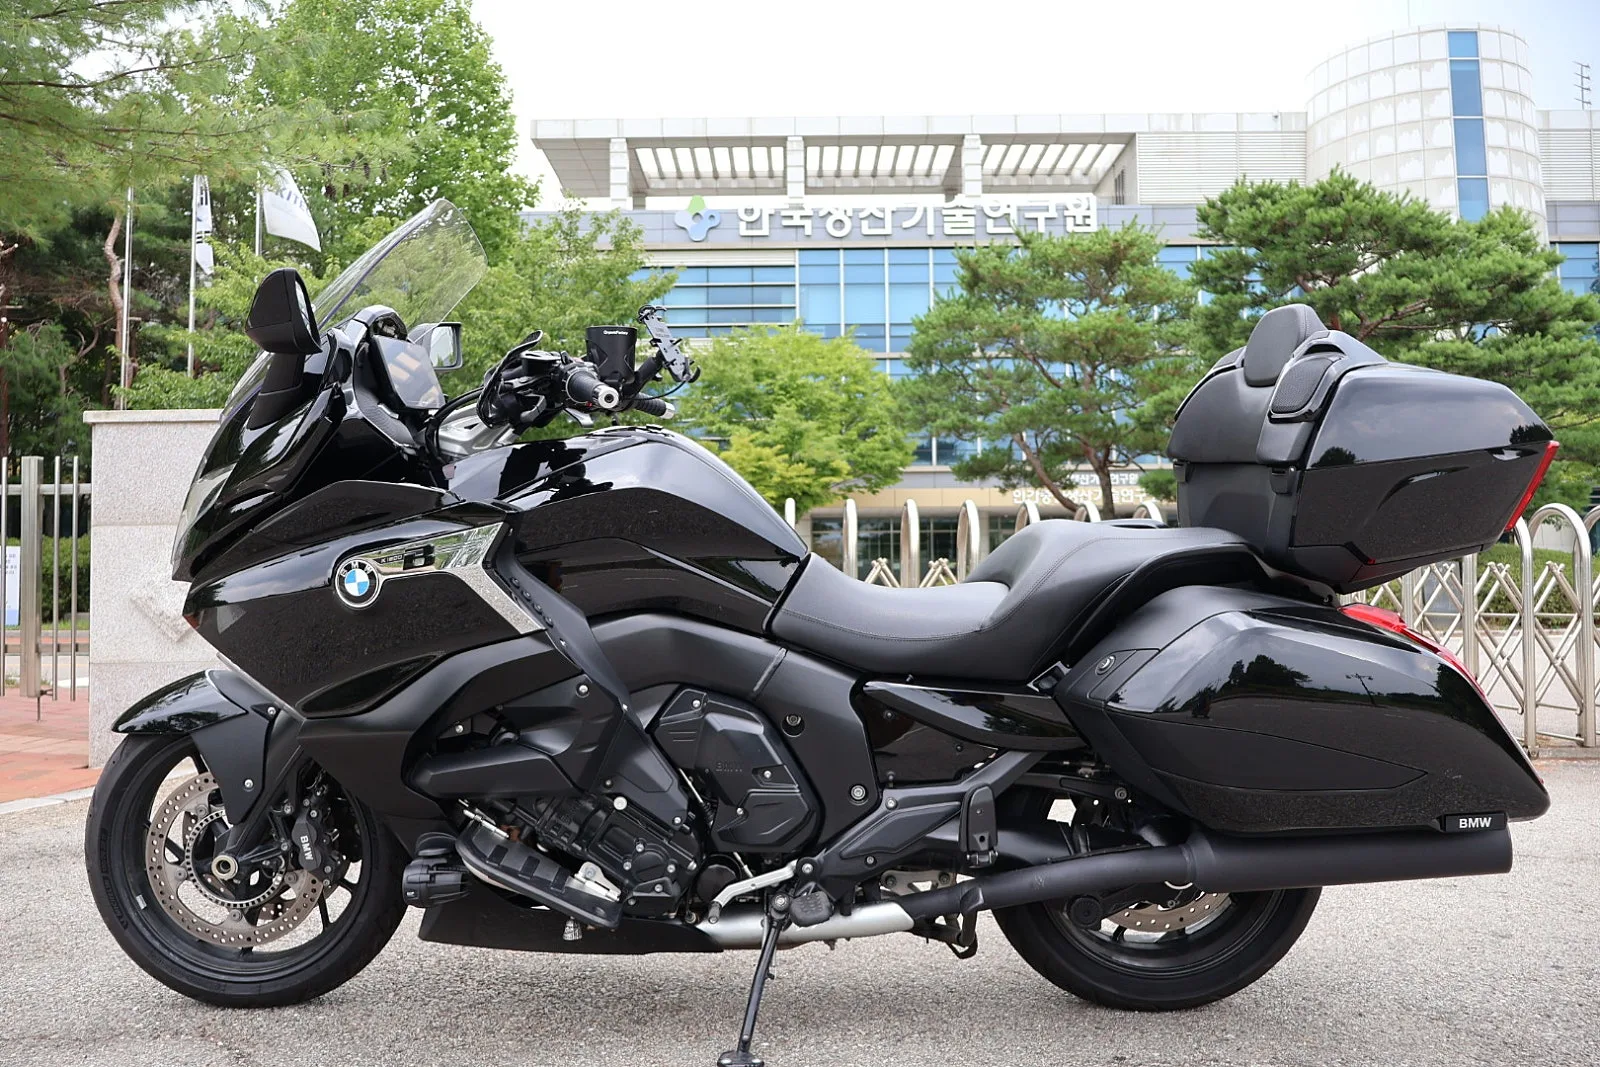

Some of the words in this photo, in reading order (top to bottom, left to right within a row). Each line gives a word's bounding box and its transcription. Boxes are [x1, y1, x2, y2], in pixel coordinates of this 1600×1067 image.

[340, 561, 373, 577] BMW
[1459, 817, 1492, 829] BMW
[300, 835, 314, 860] BMW
